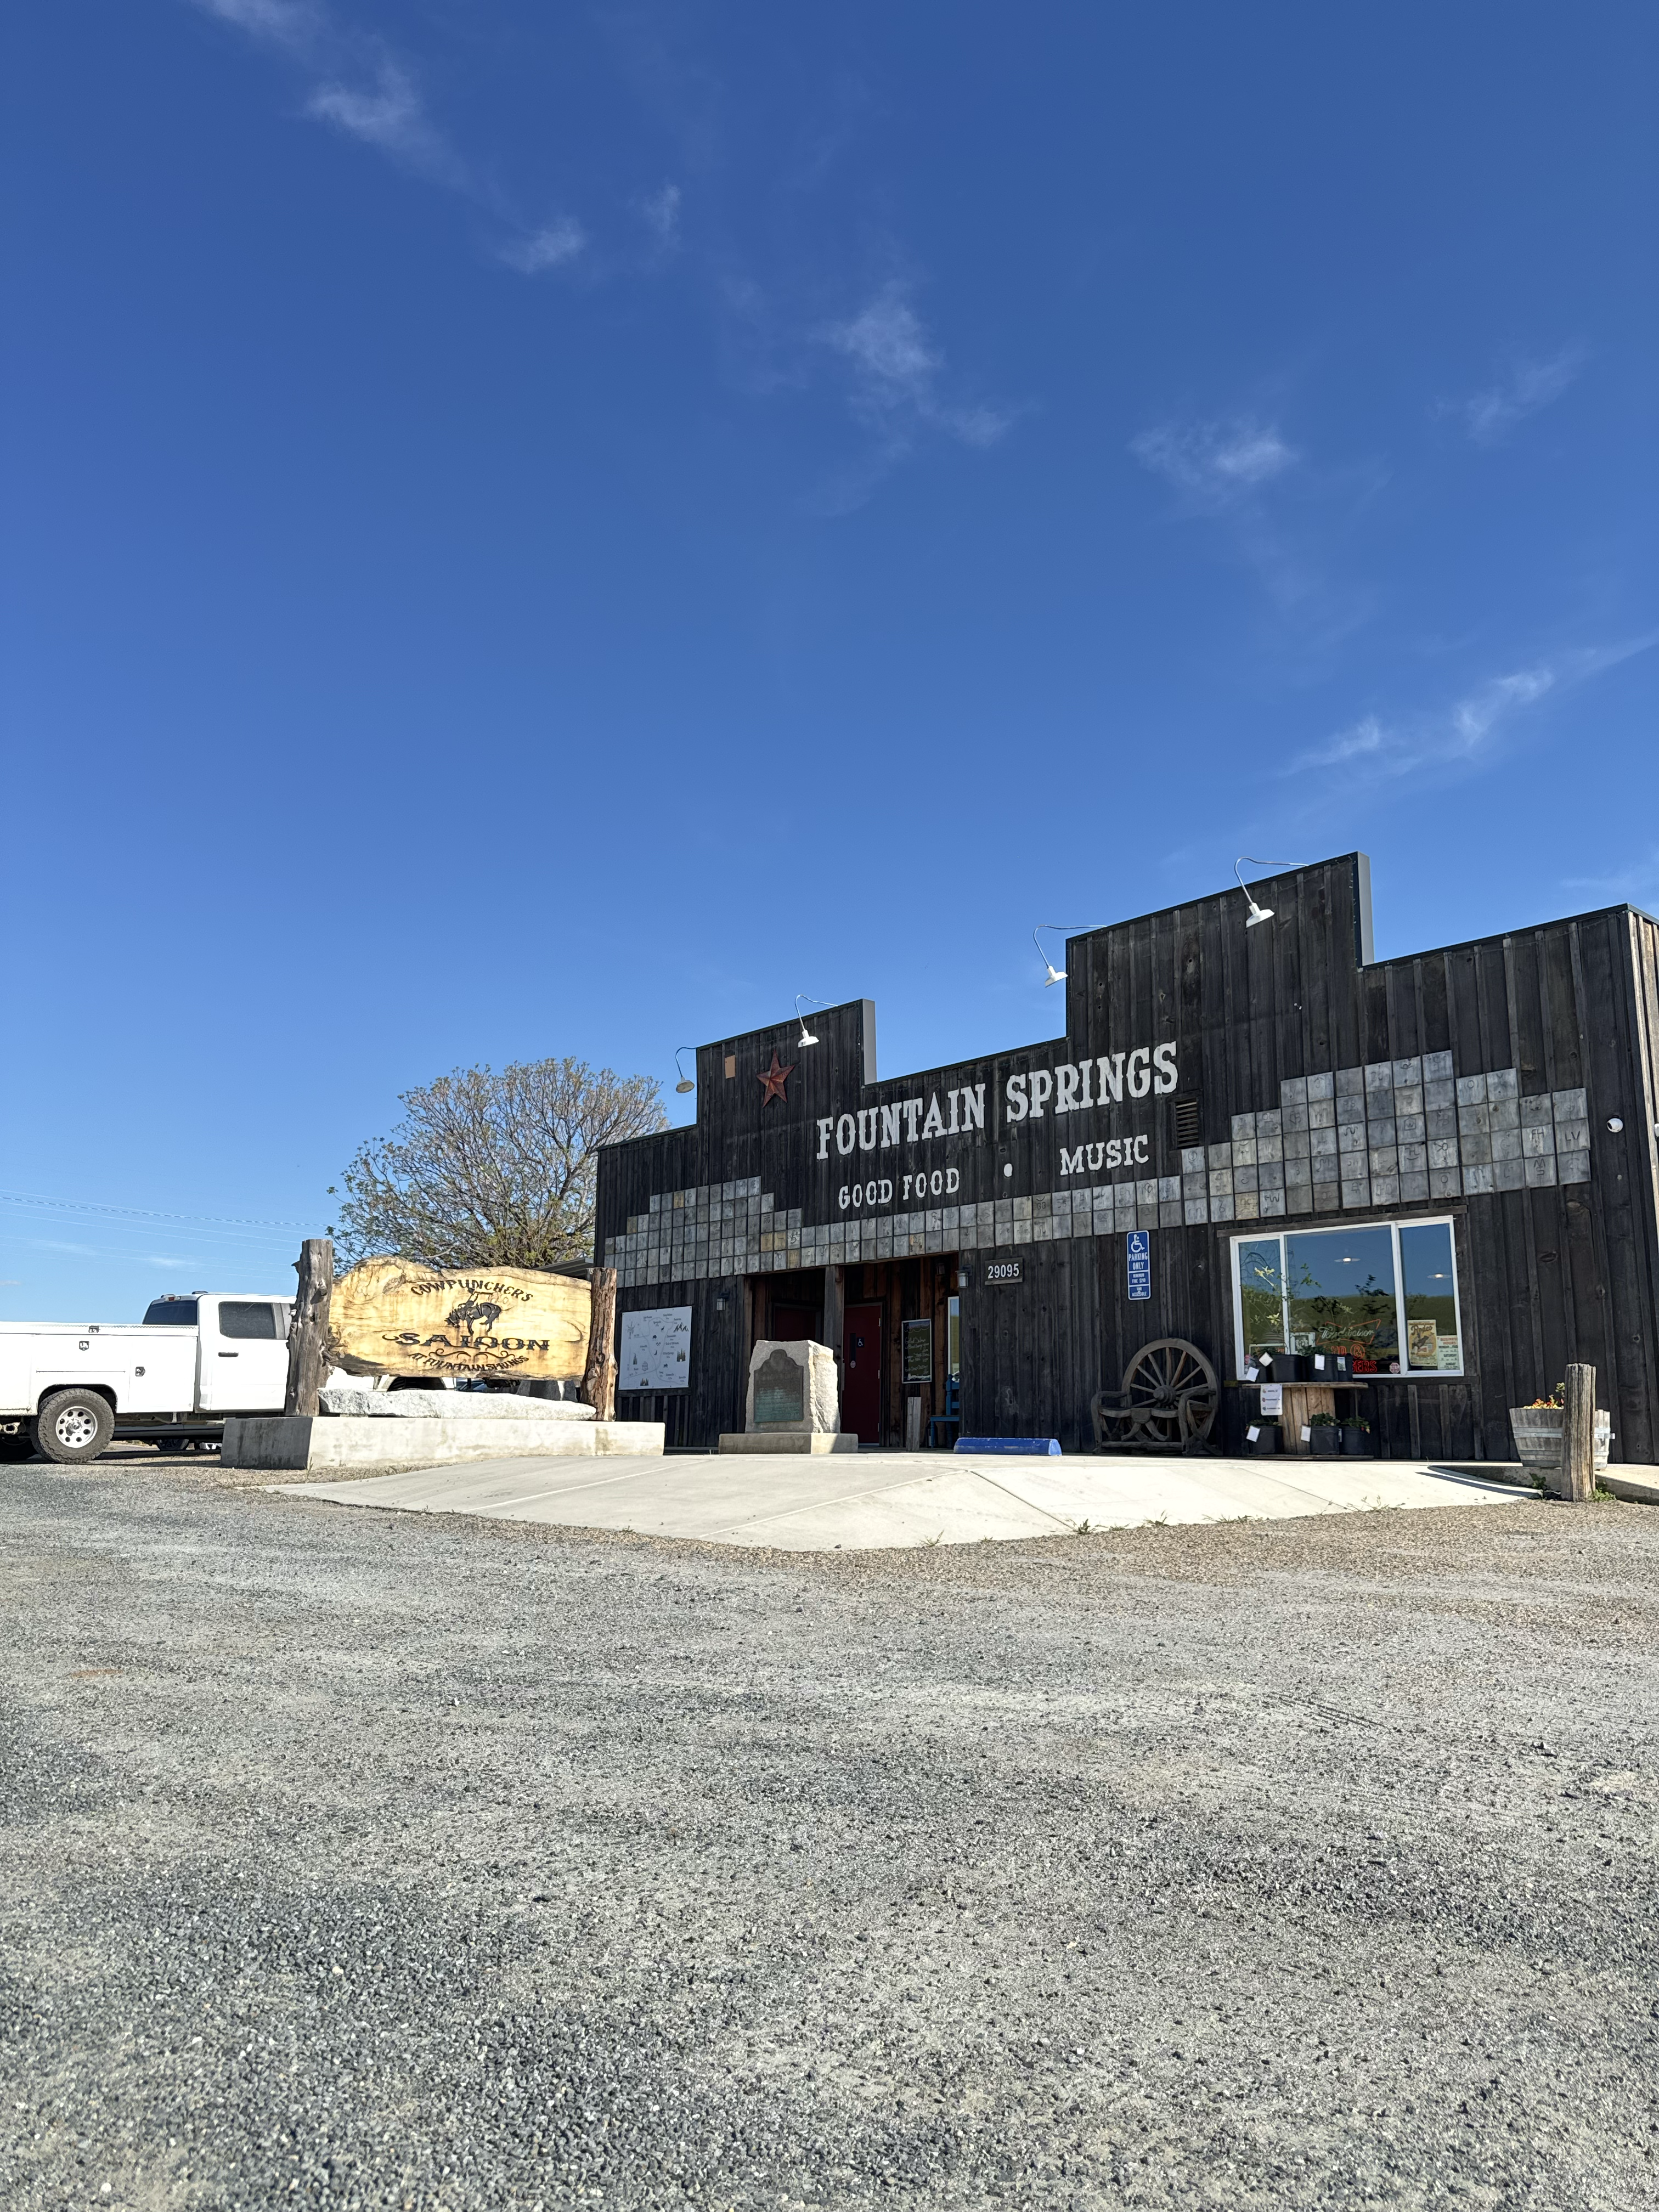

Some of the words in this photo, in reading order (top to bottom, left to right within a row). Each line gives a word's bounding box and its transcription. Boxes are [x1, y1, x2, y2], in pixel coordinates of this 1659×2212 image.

[816, 1083, 986, 1160] FOUNTAIN
[1006, 1041, 1177, 1123] SPRINGS
[1059, 1135, 1149, 1176] MUSIC
[838, 1179, 893, 1210] GOOD
[902, 1167, 960, 1200] FOOD
[1128, 1252, 1148, 1261] PARKING
[988, 1263, 1019, 1279] 29095
[1132, 1262, 1144, 1270] ONLY
[411, 1279, 533, 1302] COWPUNCHER'S
[382, 1333, 550, 1351] SALOON
[422, 1357, 485, 1372] FOUNTAIN
[485, 1355, 530, 1370] SPRINGS
